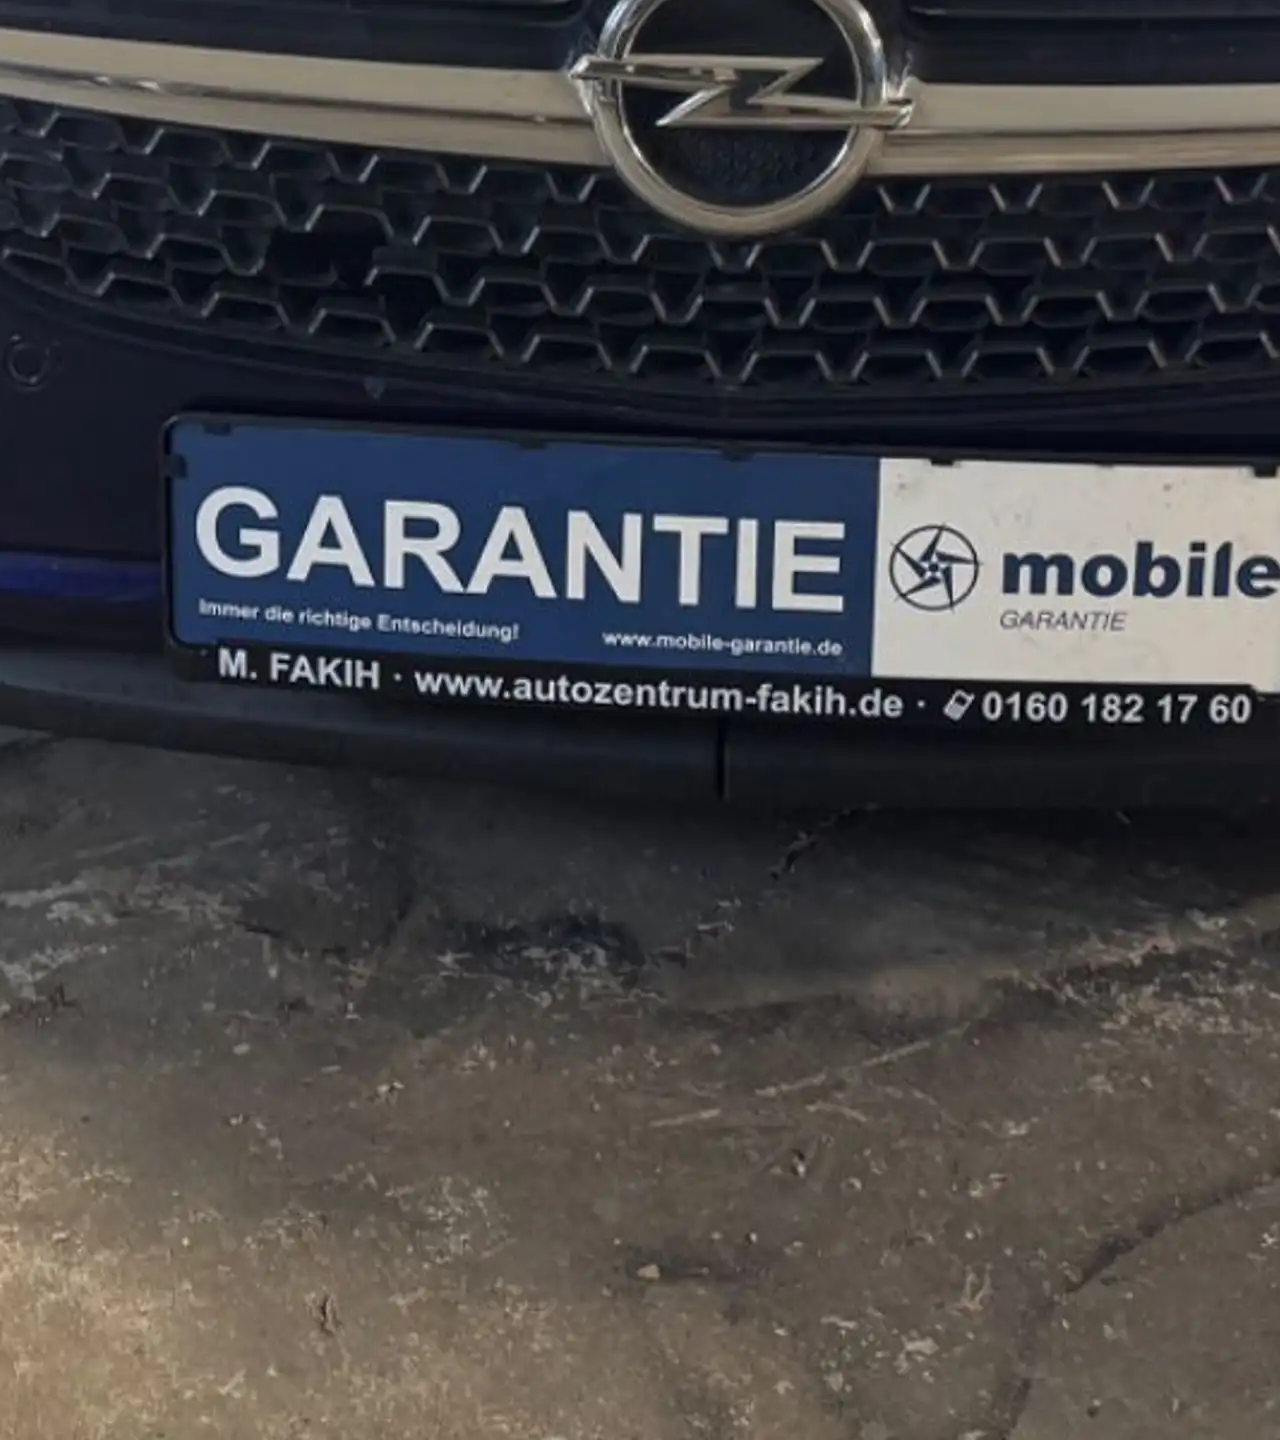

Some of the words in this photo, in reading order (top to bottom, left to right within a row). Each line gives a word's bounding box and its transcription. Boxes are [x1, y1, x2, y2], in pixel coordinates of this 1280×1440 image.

[195, 485, 845, 613] GARANTIE
[198, 598, 259, 620] Immer
[264, 605, 294, 624] die
[298, 607, 372, 633] richtige
[376, 613, 520, 643] Entscheidung!
[1000, 610, 1128, 632] GARANTIE
[601, 630, 843, 657] www.mobile-garantie.de
[218, 647, 258, 681] M.
[269, 651, 380, 690] FAKIH
[414, 668, 904, 719] www.autozentrum-fakih.de
[981, 690, 1069, 723] 0160
[1080, 692, 1145, 724] 182
[1156, 694, 1199, 724] 17
[1208, 693, 1252, 724] 60
